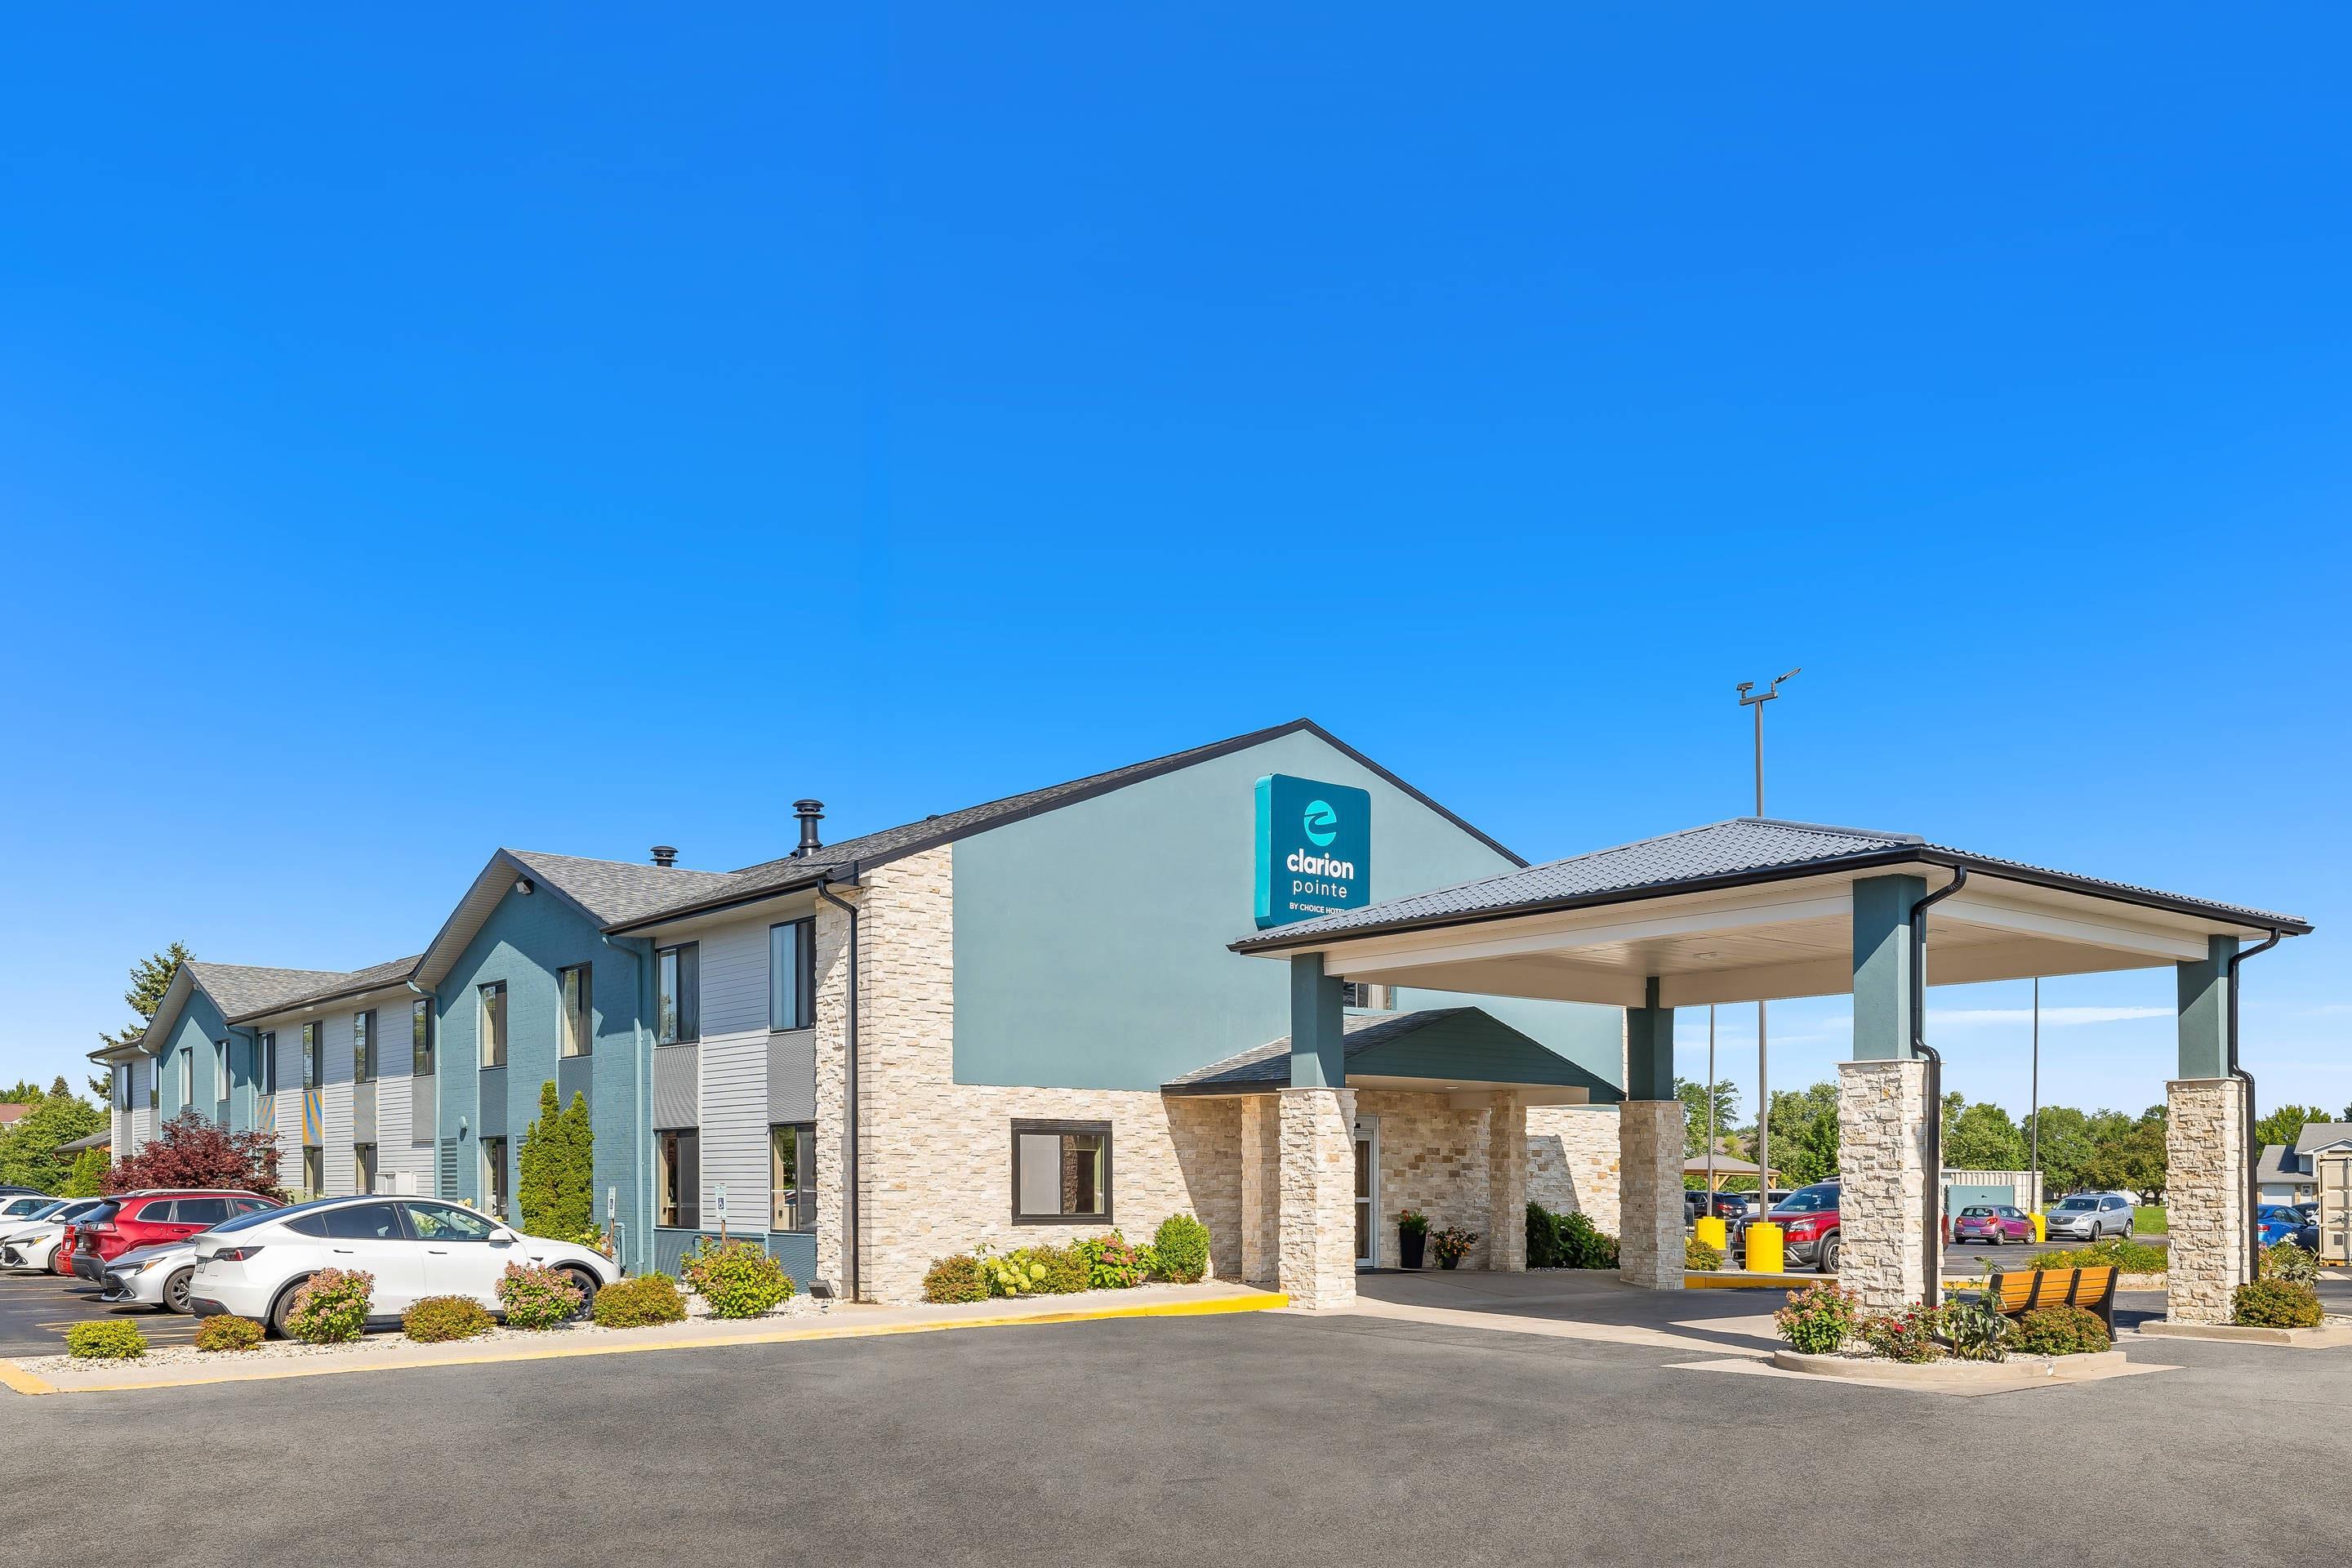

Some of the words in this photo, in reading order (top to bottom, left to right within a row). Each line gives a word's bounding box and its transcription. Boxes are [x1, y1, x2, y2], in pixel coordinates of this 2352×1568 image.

[1286, 848, 1354, 880] clarion
[1293, 880, 1348, 898] pointe
[1290, 902, 1298, 910] BY
[1299, 903, 1325, 913] CHOICE
